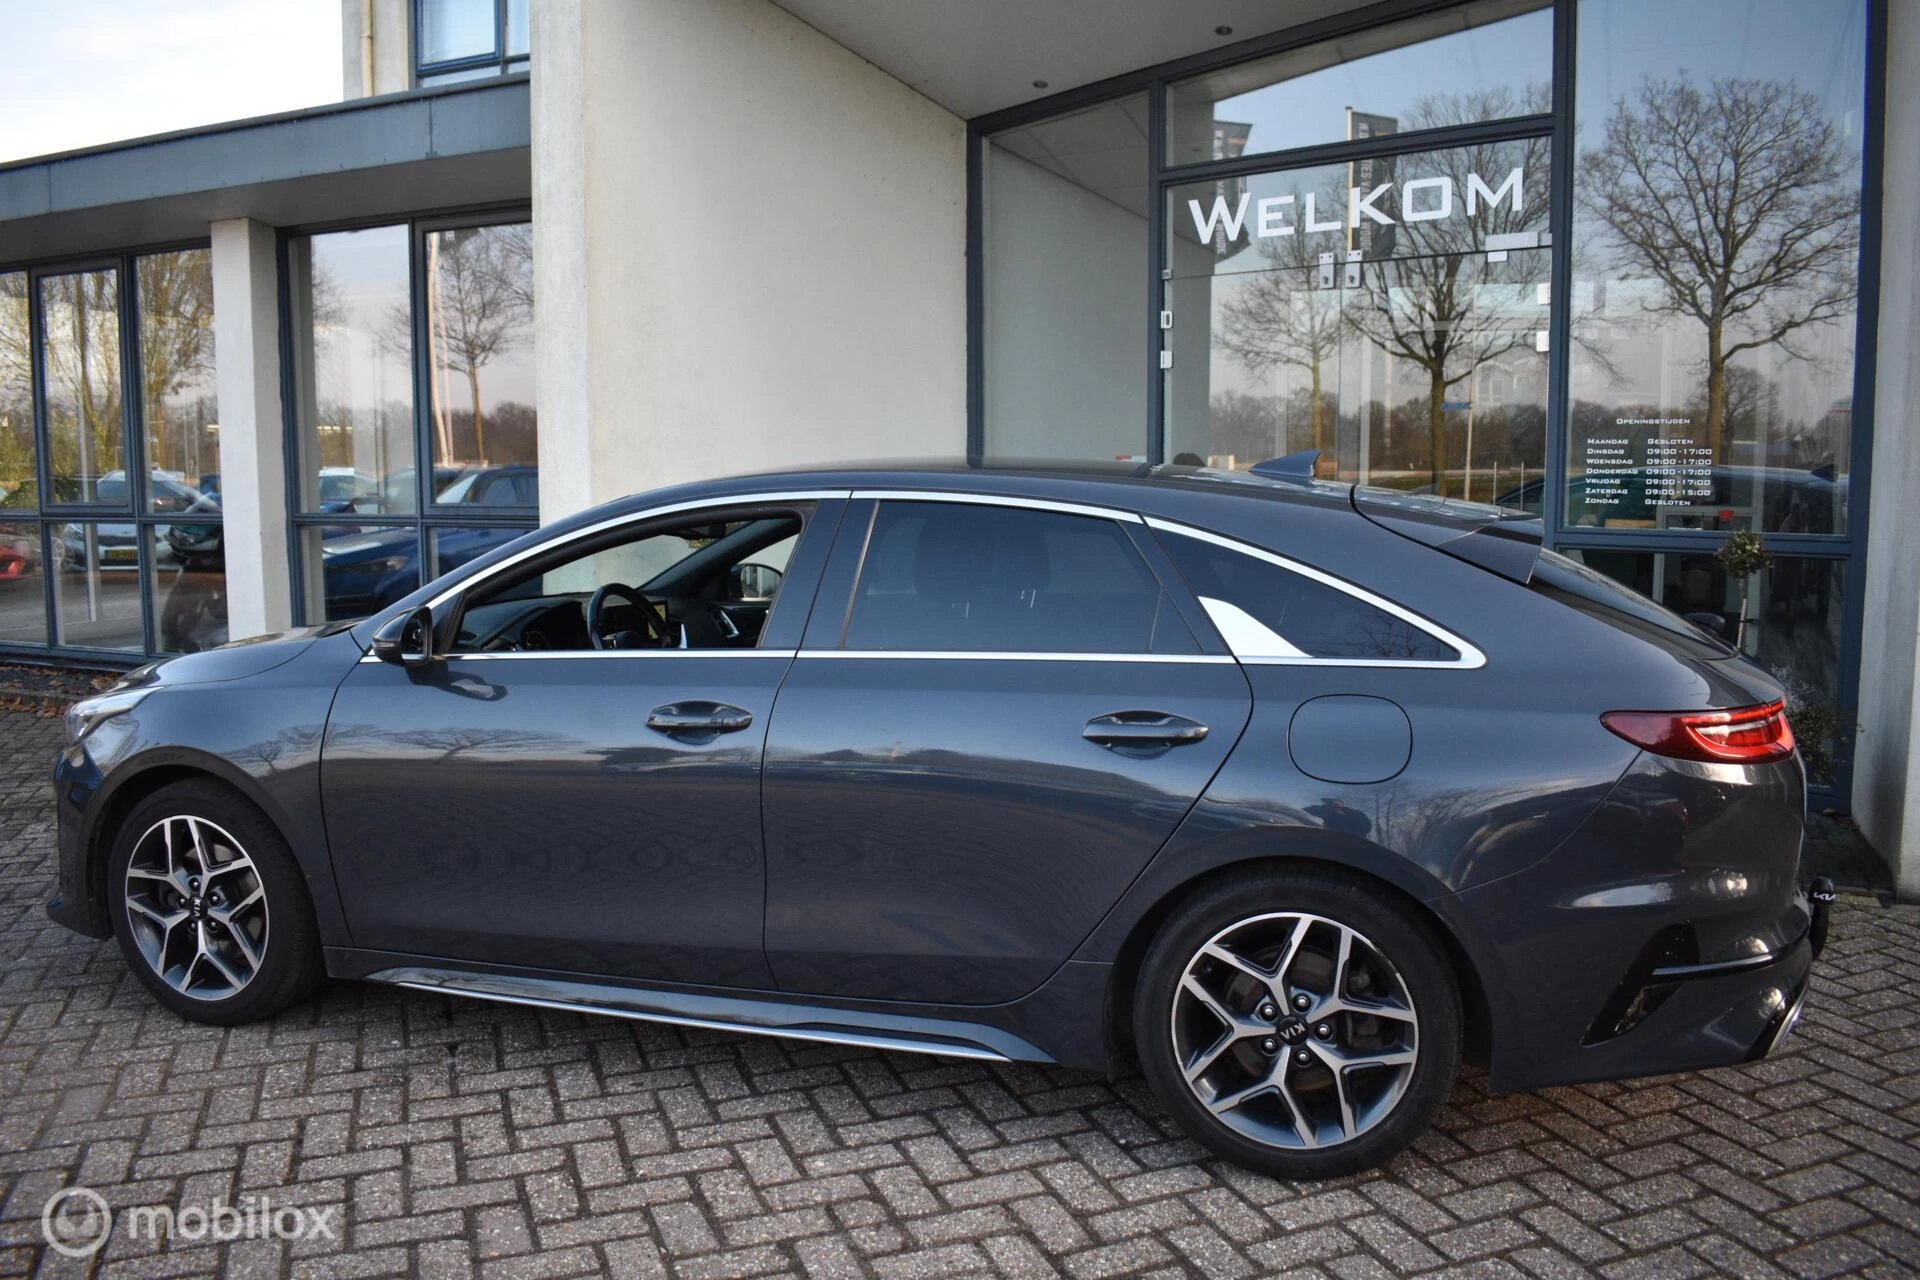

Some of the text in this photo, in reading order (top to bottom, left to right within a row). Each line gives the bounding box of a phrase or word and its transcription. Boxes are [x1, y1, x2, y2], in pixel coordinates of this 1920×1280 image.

[1187, 167, 1523, 244] WELKOM
[193, 899, 201, 917] KIA
[1280, 1023, 1306, 1040] KIA
